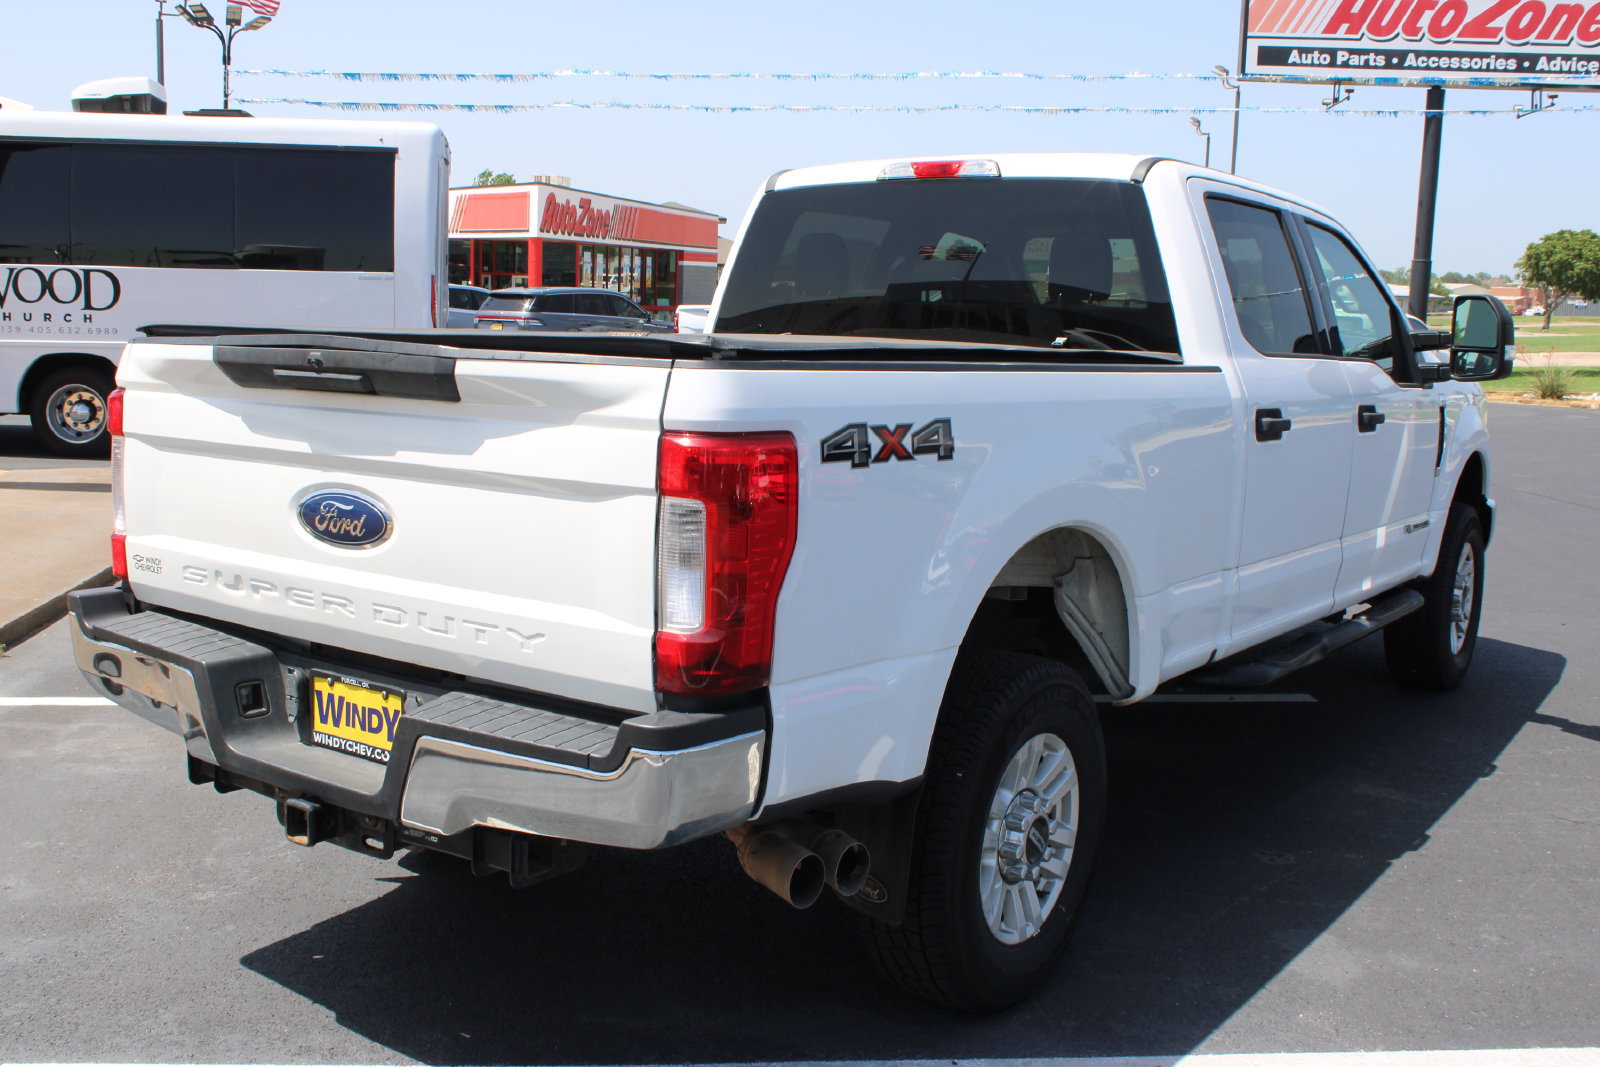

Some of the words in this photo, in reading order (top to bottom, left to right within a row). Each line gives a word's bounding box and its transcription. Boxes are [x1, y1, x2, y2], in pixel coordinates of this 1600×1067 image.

[1287, 49, 1331, 65] Auto
[1336, 50, 1386, 67] Parts
[1403, 53, 1518, 71] Accessories
[1535, 56, 1600, 73] Advice
[539, 192, 611, 240] AutoZone
[314, 500, 367, 537] Ford
[182, 564, 356, 619] SUPER
[372, 602, 546, 654] DUTY
[315, 690, 400, 743] WINDY
